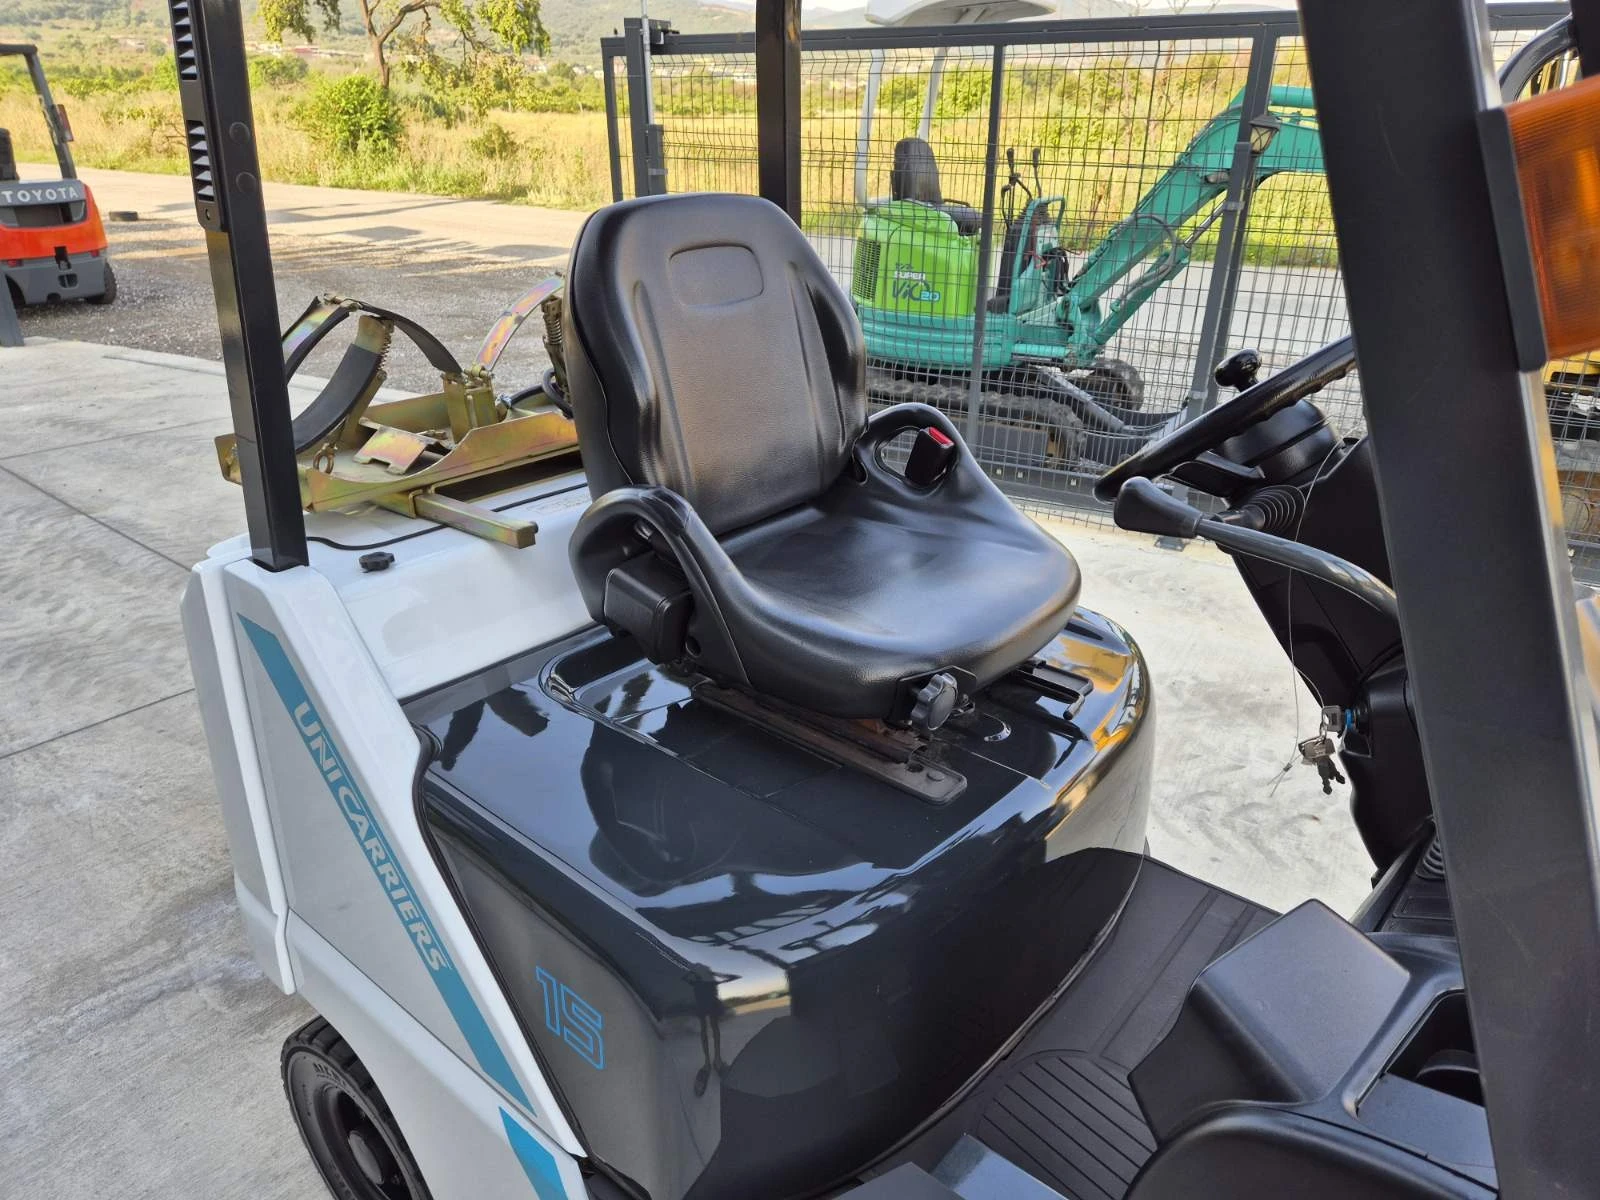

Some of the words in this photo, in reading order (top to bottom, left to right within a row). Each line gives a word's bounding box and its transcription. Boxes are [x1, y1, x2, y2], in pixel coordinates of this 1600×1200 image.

[1, 186, 79, 204] TOYOTA
[293, 701, 447, 971] UNICARRIERS
[535, 965, 604, 1070] 15
